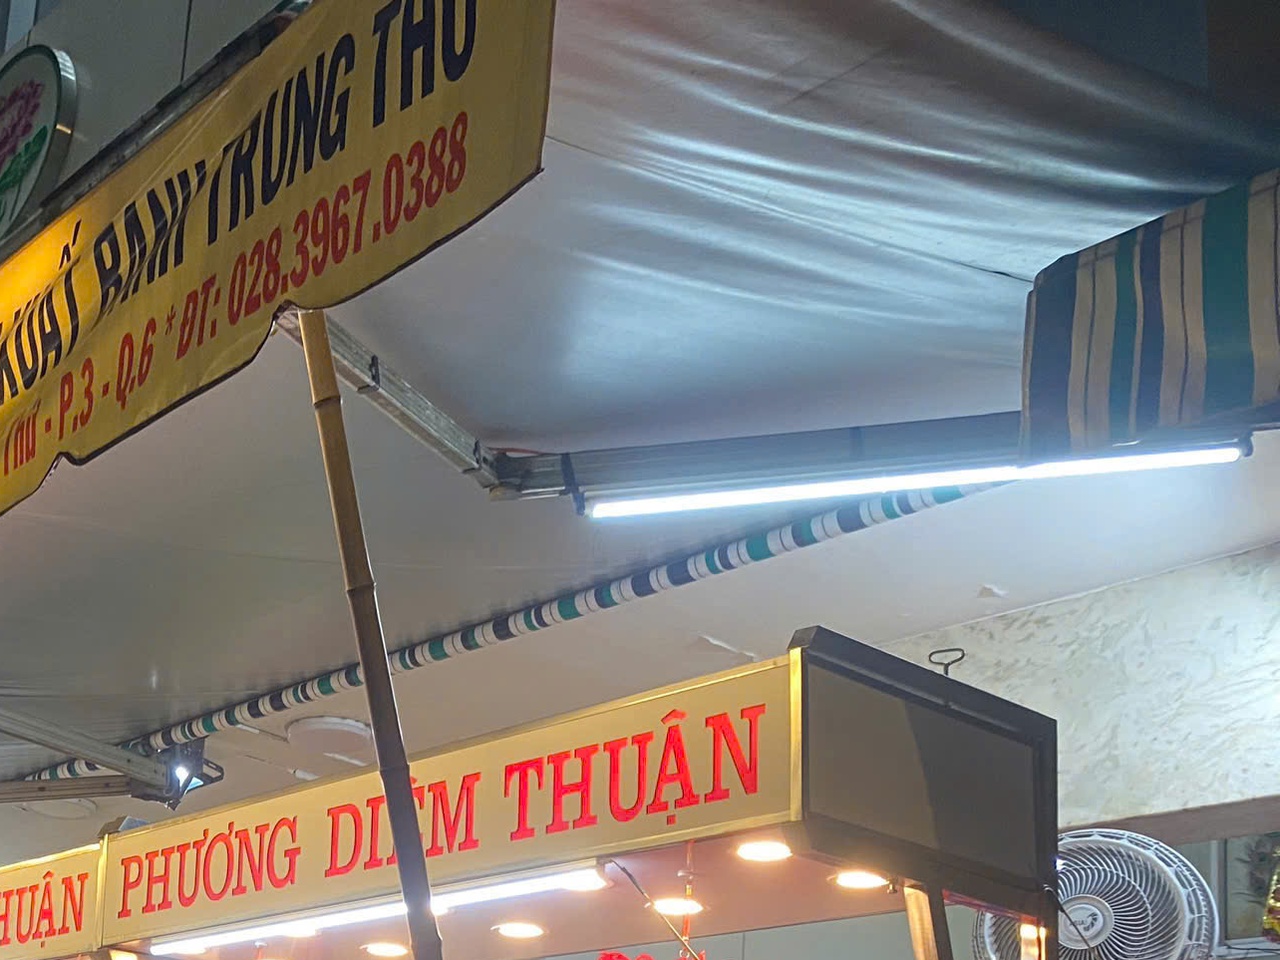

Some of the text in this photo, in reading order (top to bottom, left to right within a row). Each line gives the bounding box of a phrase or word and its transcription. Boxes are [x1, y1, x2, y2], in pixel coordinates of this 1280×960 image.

[206, 33, 356, 247] TRUNG
[371, 0, 477, 128] THU
[58, 357, 94, 441] P.3
[116, 318, 156, 410] Q.6
[176, 274, 220, 360] ĐT:
[226, 111, 468, 326] 028.3967.0388
[118, 816, 301, 919] PHƯƠNG
[504, 703, 767, 842] THUẬN
